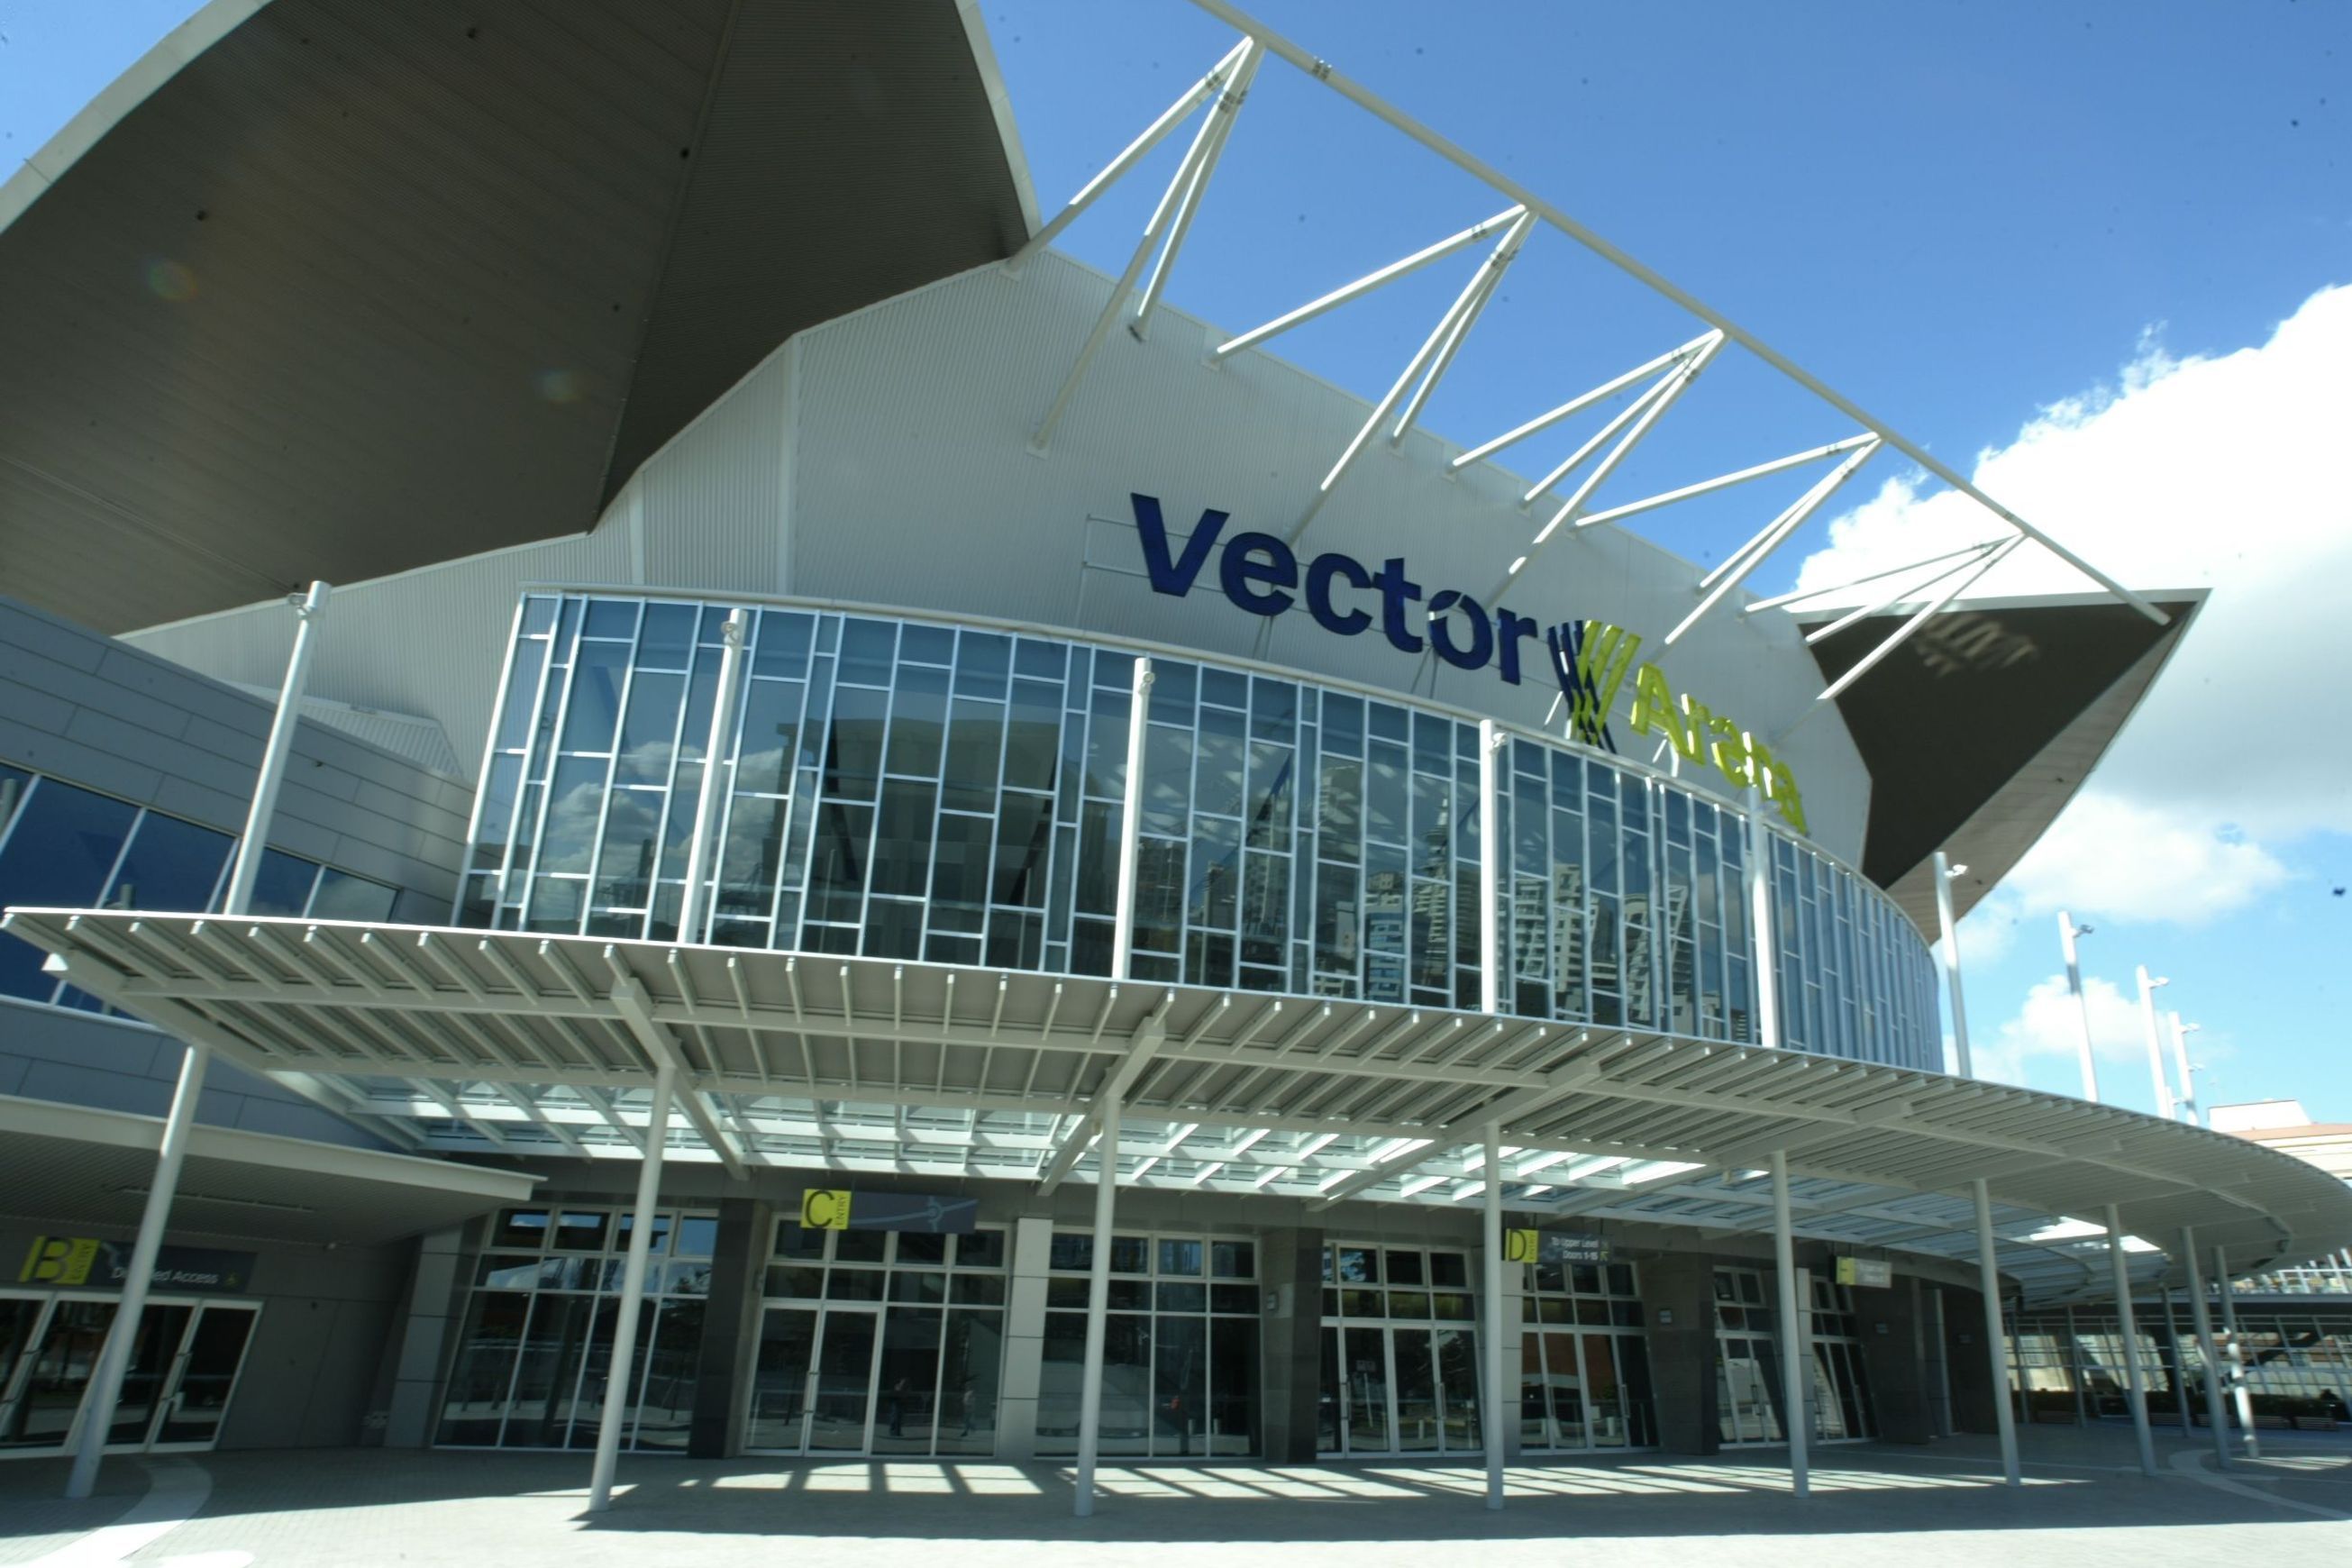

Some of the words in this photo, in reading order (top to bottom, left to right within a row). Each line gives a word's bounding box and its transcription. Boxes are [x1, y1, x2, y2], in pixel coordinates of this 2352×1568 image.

[1130, 492, 1537, 686] Vector
[1630, 661, 1808, 835] Arena
[807, 1190, 834, 1226] C
[836, 1197, 845, 1225] ENTRY
[28, 1235, 74, 1282] B
[1509, 1230, 1526, 1261] D
[172, 1270, 219, 1284] Access
